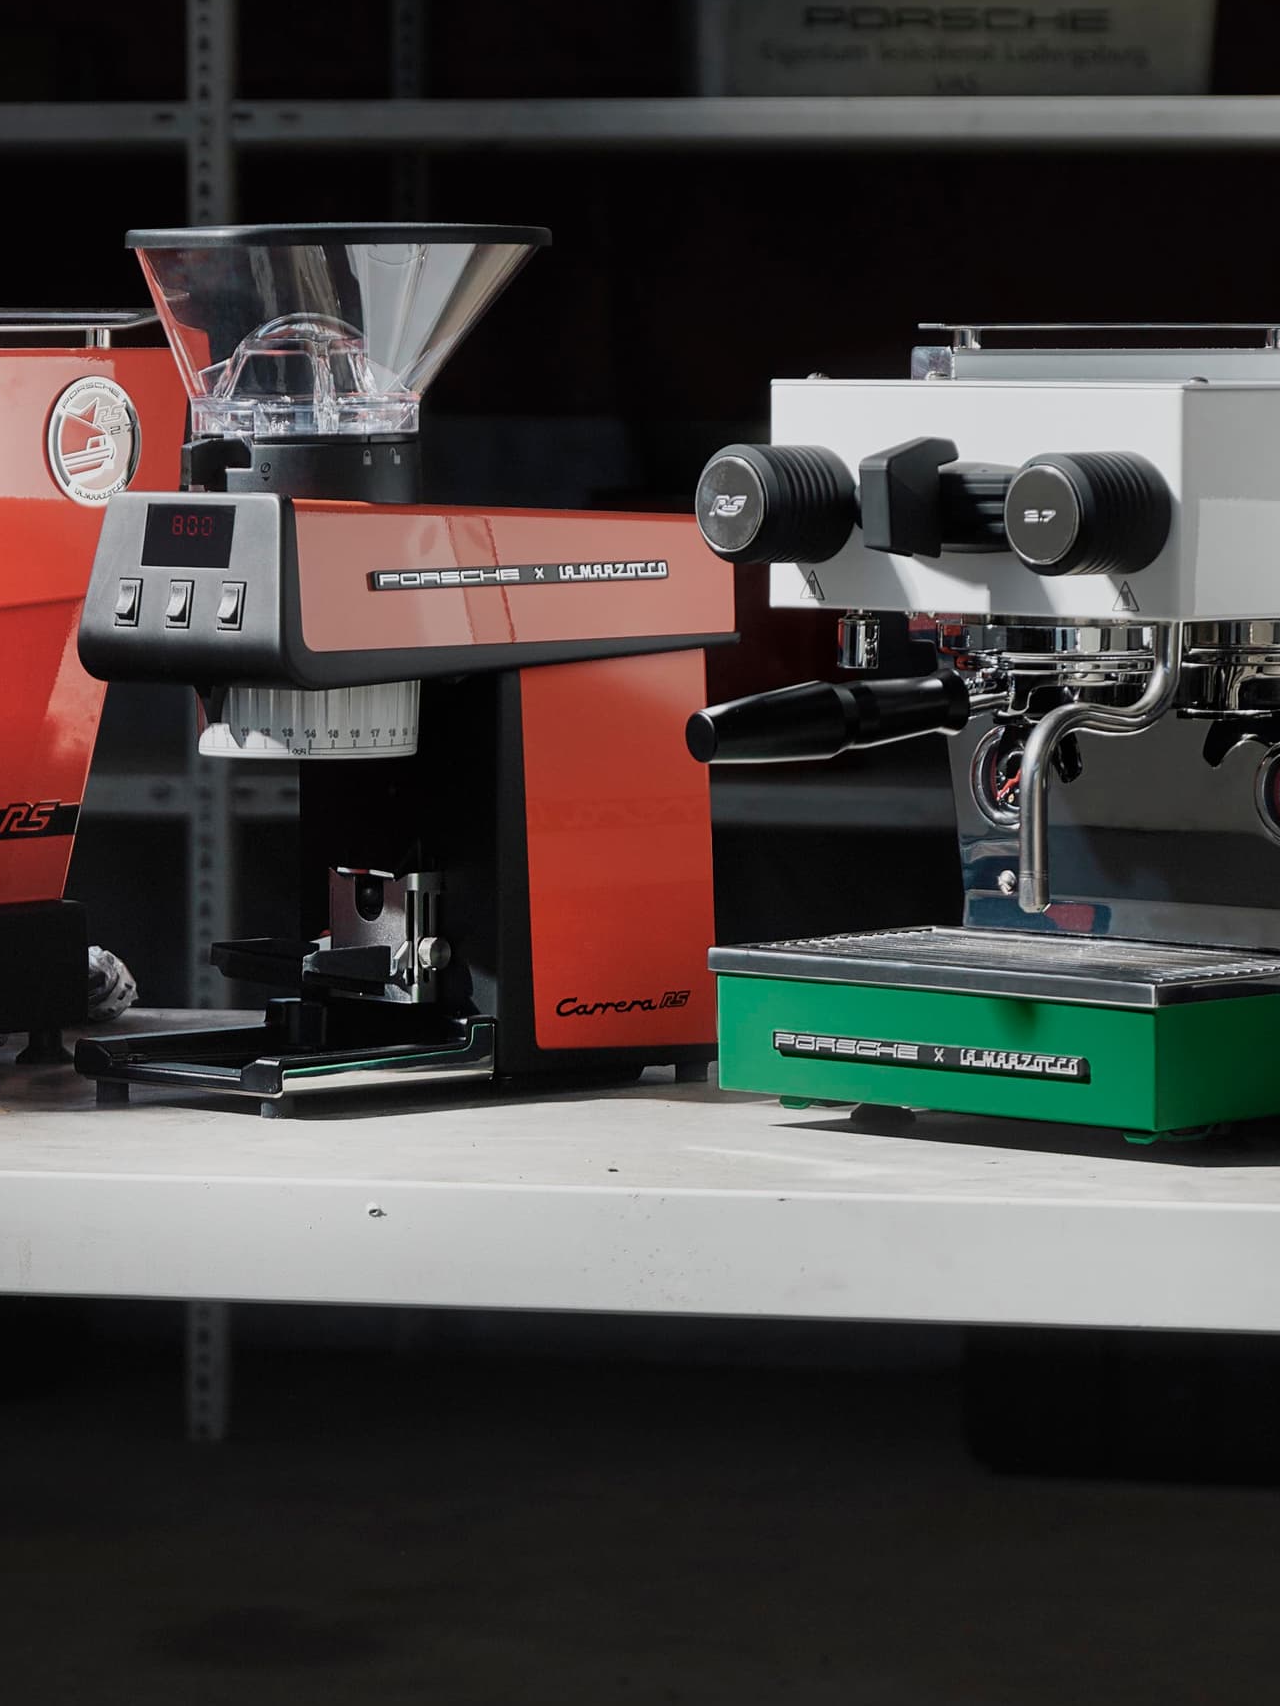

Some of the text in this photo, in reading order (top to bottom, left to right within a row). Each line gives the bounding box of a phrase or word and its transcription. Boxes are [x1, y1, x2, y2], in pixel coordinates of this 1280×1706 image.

[803, 5, 1110, 32] PORSCHE
[62, 381, 121, 410] PORSCHE
[708, 494, 748, 518] RS
[172, 514, 214, 537] 800
[379, 568, 520, 586] PORSCHE
[556, 990, 691, 1017] Carrera RS
[775, 1032, 919, 1060] PORSCHE
